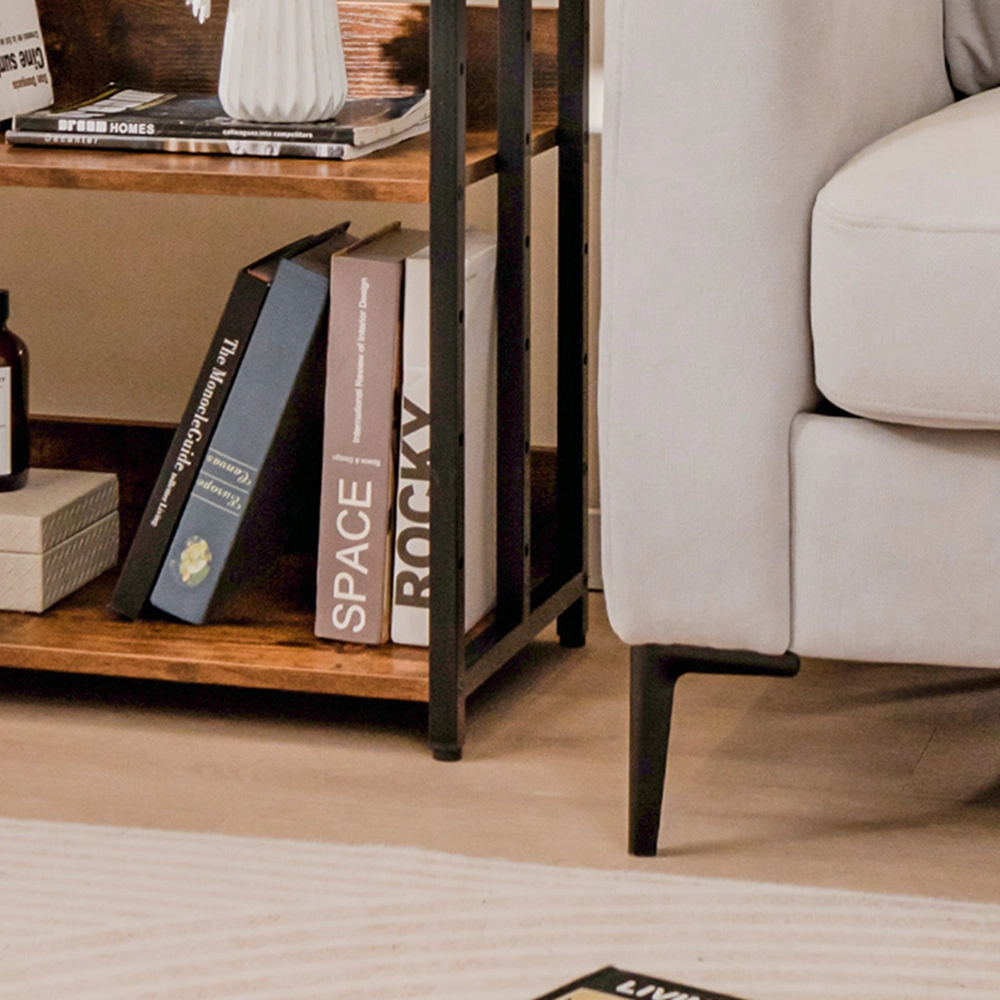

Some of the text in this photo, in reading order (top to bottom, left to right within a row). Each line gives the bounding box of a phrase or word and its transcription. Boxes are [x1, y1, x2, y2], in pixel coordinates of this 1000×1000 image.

[19, 47, 45, 70] Cine
[109, 122, 155, 135] HOMES
[215, 338, 239, 367] The
[332, 479, 372, 633] SPACE
[352, 389, 363, 444] International
[358, 276, 369, 308] Design
[395, 396, 430, 609] ROCKY
